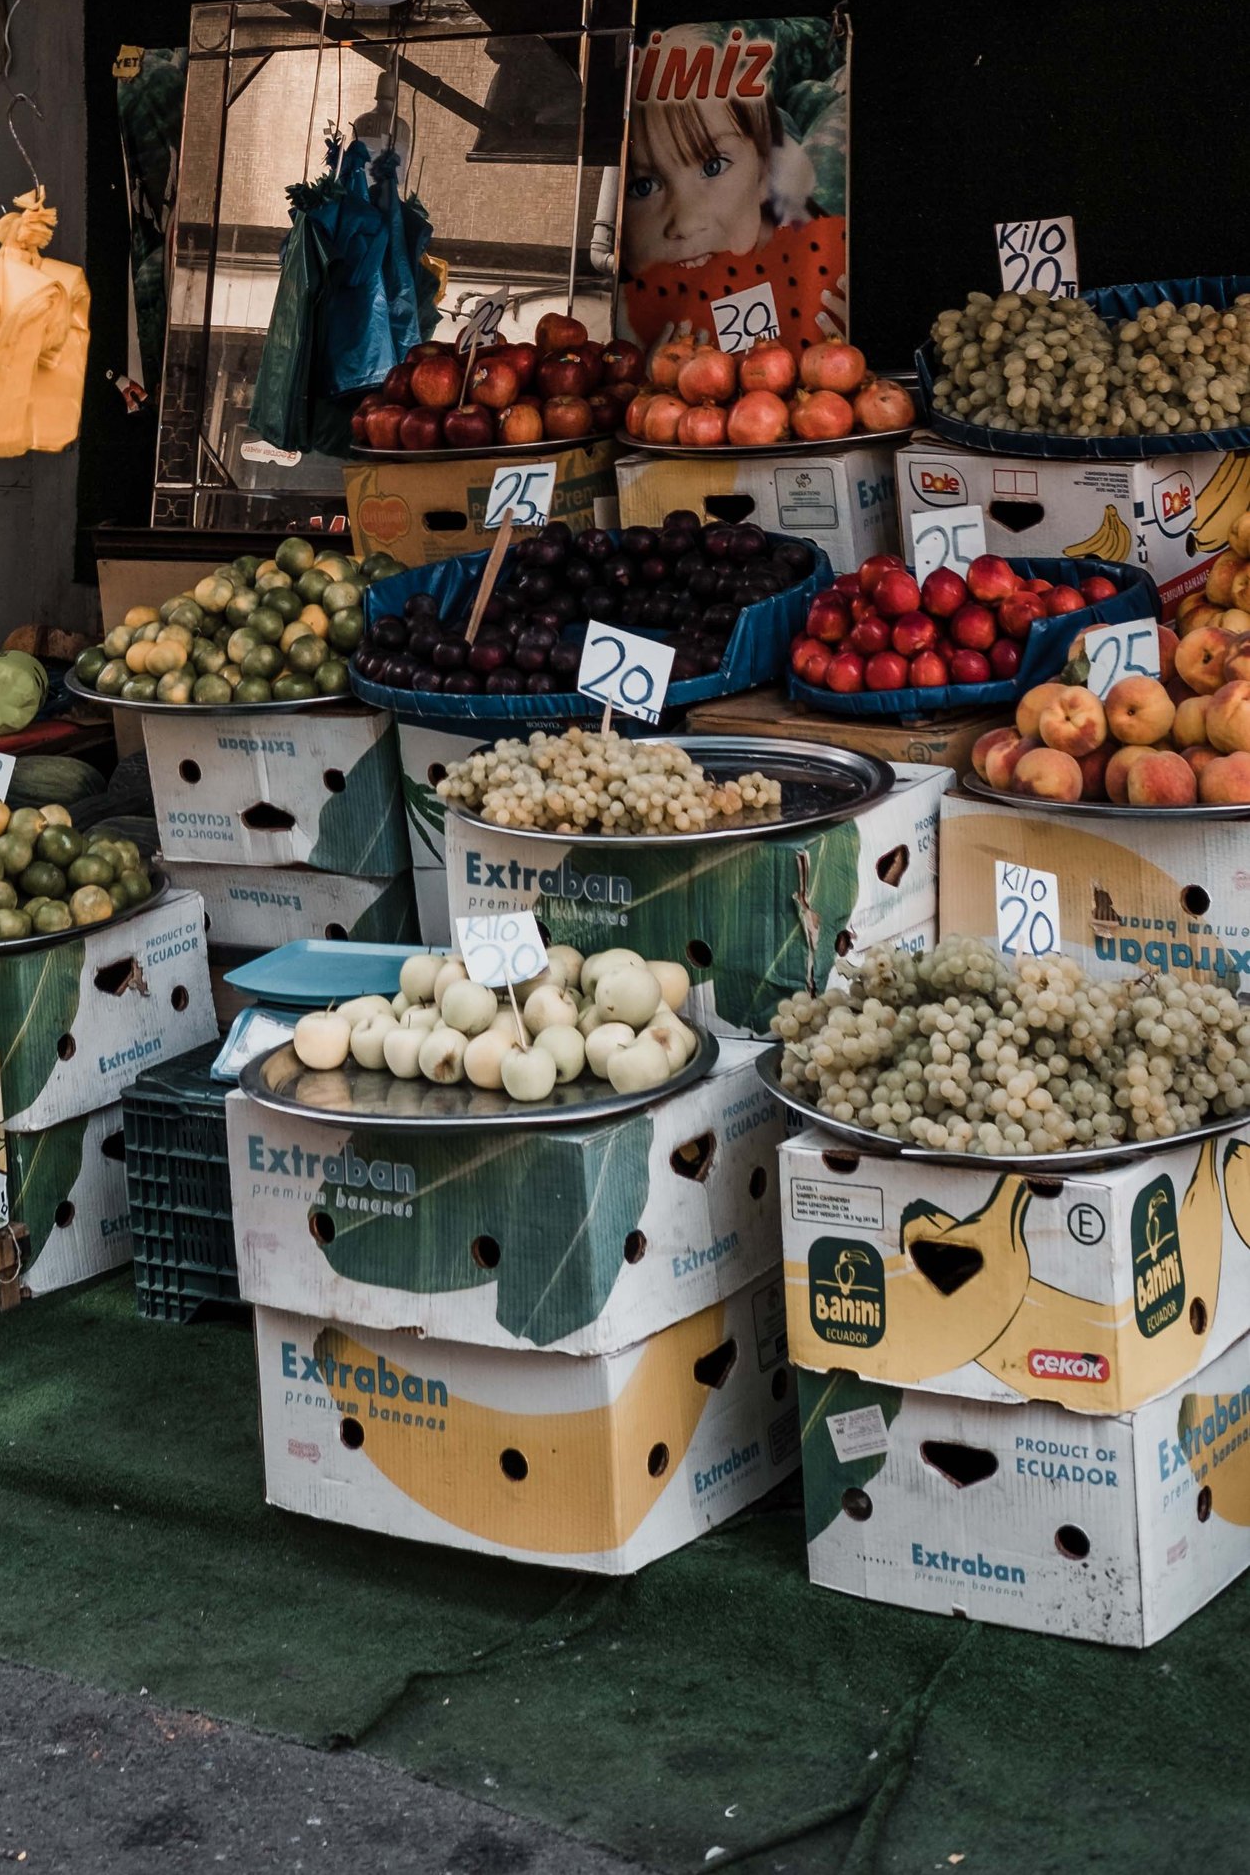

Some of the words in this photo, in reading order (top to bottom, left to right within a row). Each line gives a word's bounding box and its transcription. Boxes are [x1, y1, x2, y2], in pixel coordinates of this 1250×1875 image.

[633, 29, 774, 102] İMİZ
[999, 220, 1067, 255] Kilo
[1004, 252, 1063, 300] 20
[713, 300, 771, 354] 30
[484, 472, 549, 527] 25
[921, 470, 959, 494] Dole
[1161, 483, 1191, 519] Dole
[915, 523, 980, 575] 25
[579, 636, 654, 709] 20
[1092, 629, 1161, 702] 25
[217, 737, 296, 757] Extraban
[168, 811, 232, 826] ECUADOR
[170, 828, 185, 839] OF
[187, 829, 234, 842] PRODUCT
[466, 851, 632, 905] Extraban
[1002, 862, 1048, 903] Kilo
[229, 887, 302, 911] Extraban
[146, 927, 183, 950] PRODUCT
[184, 922, 198, 937] OF
[465, 915, 521, 942] Kilo
[1000, 895, 1055, 957] 20
[1119, 916, 1178, 938] banan
[1187, 920, 1250, 940] emium
[147, 937, 199, 967] ECUADOR
[468, 941, 542, 985] 20
[1095, 935, 1250, 979] xtraban
[99, 1036, 163, 1075] Extraban
[725, 1104, 779, 1143] ECUADOR
[248, 1135, 416, 1196] Extraban
[252, 1181, 327, 1206] premium
[335, 1187, 414, 1219] bananas
[101, 1210, 132, 1238] Extr
[1078, 1209, 1094, 1239] E
[672, 1231, 739, 1279] Extraban
[1136, 1249, 1181, 1313] Banini
[814, 1292, 881, 1329] Banini
[1145, 1300, 1178, 1333] ECUADOR
[825, 1327, 869, 1345] ECUADOR
[281, 1341, 448, 1408] Extraban
[285, 1389, 359, 1417] premium
[368, 1398, 447, 1433] bananas
[693, 1440, 761, 1496] Extraban
[1015, 1436, 1089, 1460] PRODUCT
[1095, 1447, 1118, 1463] OF
[1015, 1456, 1120, 1489] ECUADOR
[1162, 1460, 1209, 1514] premium
[910, 1542, 1027, 1585] Extraban
[913, 1570, 966, 1589] premium
[971, 1576, 1025, 1599] bananas
